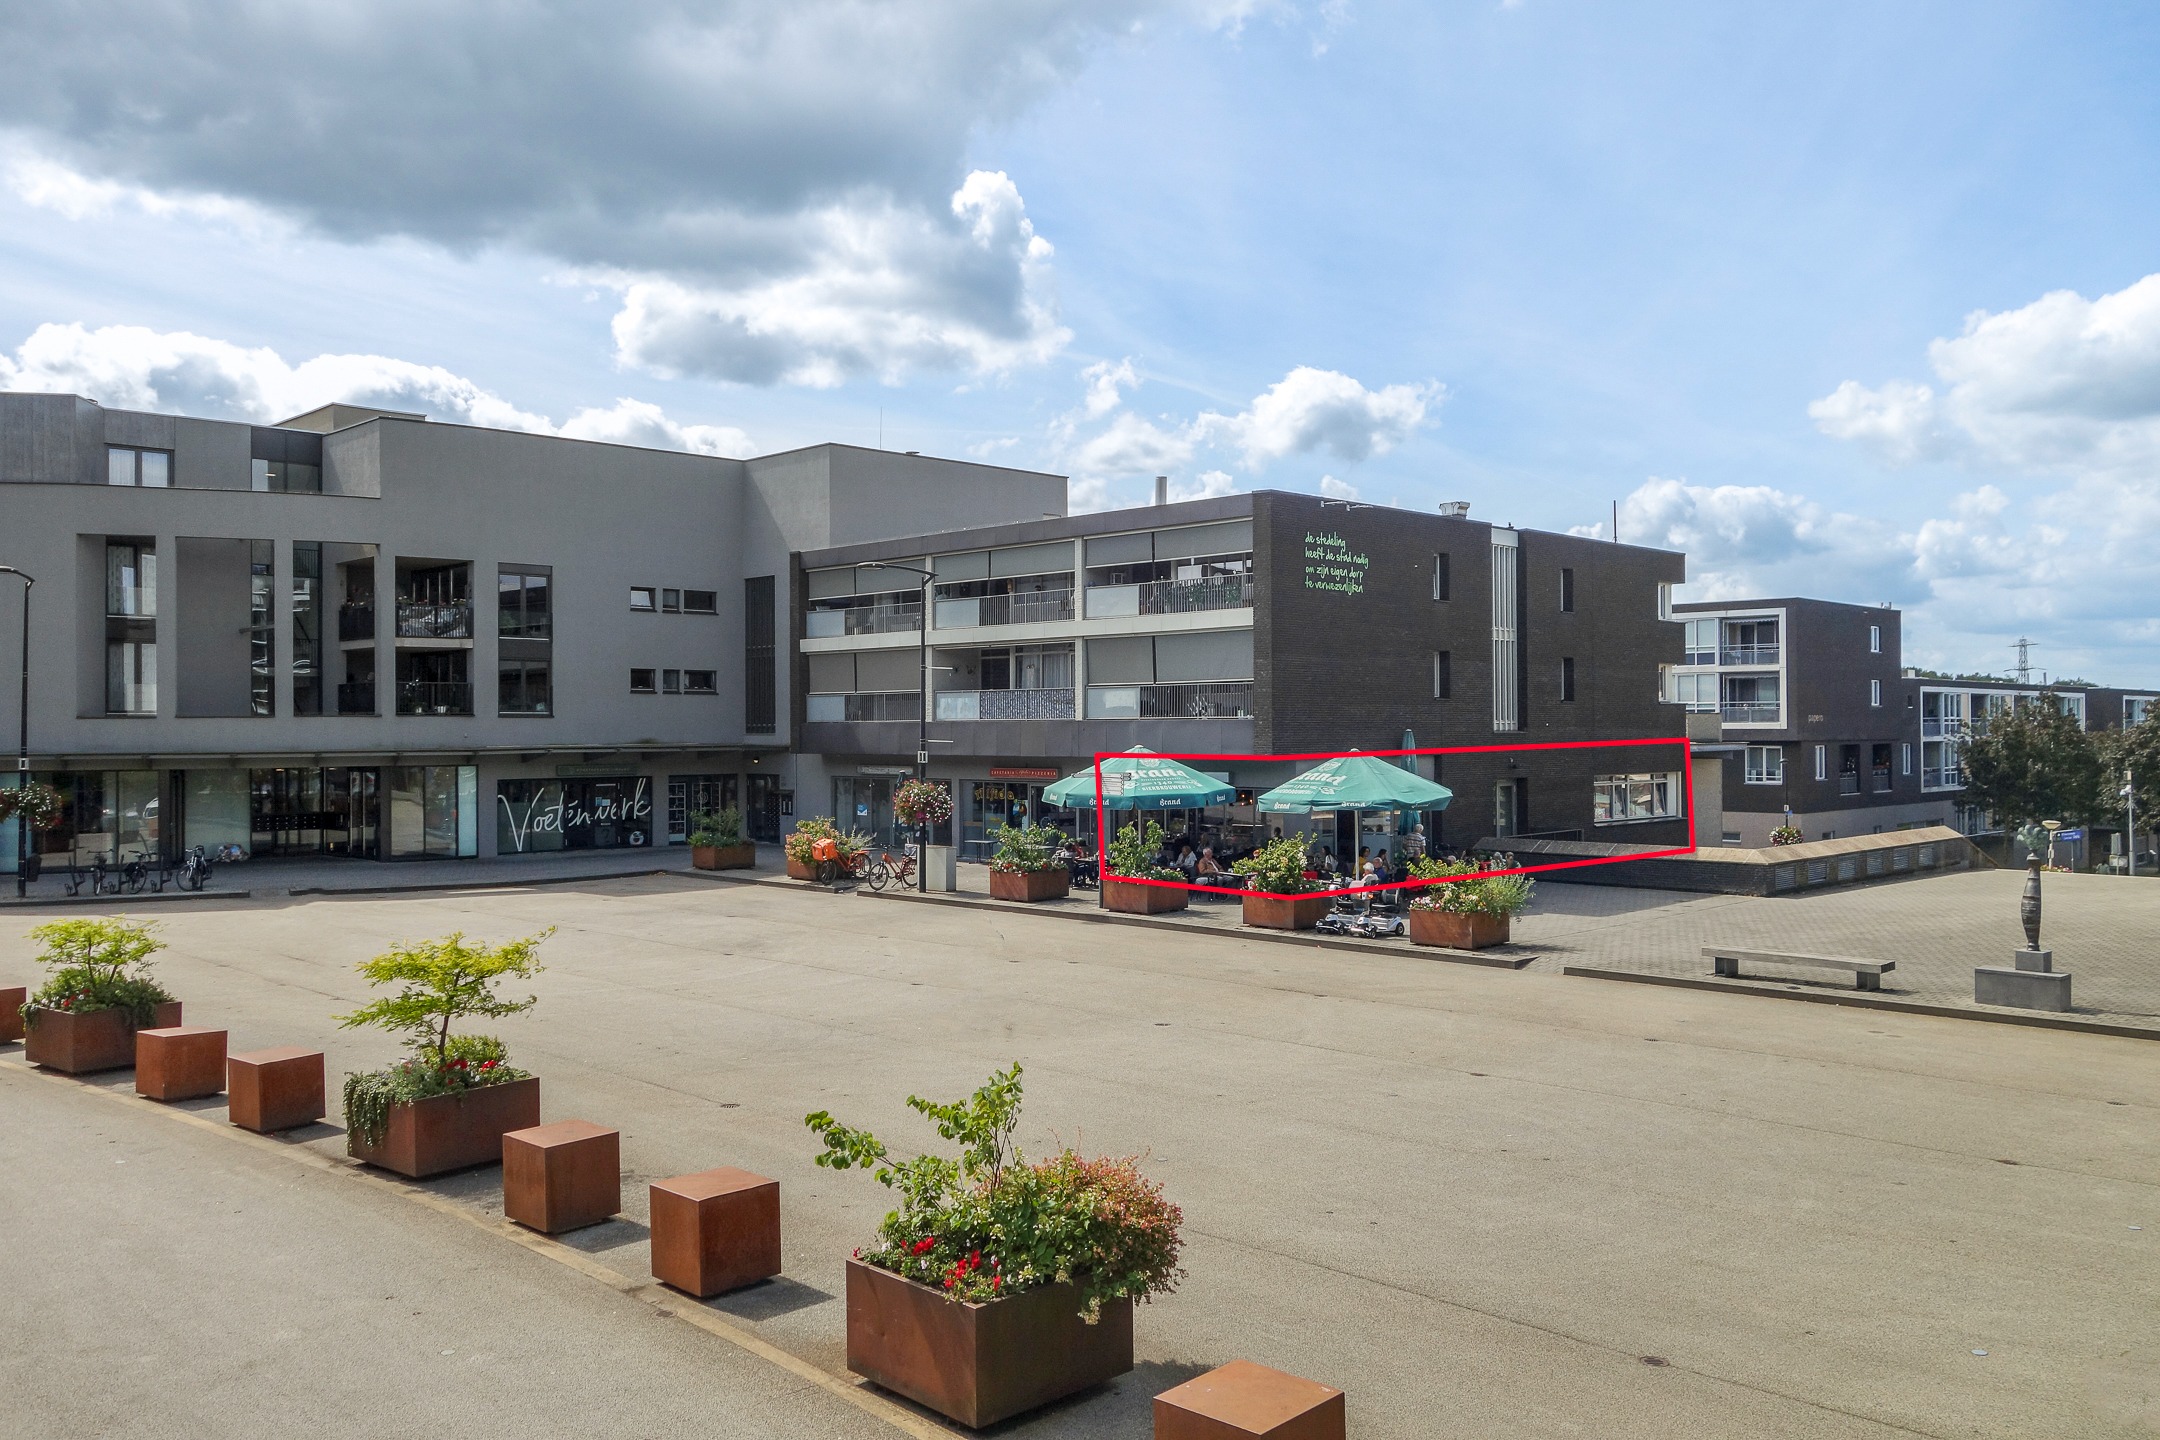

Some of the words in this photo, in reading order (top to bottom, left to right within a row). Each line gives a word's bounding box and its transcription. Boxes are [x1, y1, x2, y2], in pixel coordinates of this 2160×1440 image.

[1305, 531, 1315, 543] de
[1316, 531, 1346, 552] stedeling
[1305, 546, 1325, 560] heeft
[1326, 548, 1336, 560] de
[1336, 550, 1352, 563] stad
[1353, 552, 1369, 569] nodig
[1305, 566, 1315, 574] om
[1316, 563, 1329, 579] zijn
[1330, 564, 1348, 581] eigen
[1349, 566, 1364, 583] dorp
[1304, 575, 1314, 588] te
[1315, 577, 1364, 596] verwezenlijken
[1159, 798, 1181, 807] Brand
[1274, 801, 1291, 810] Brand
